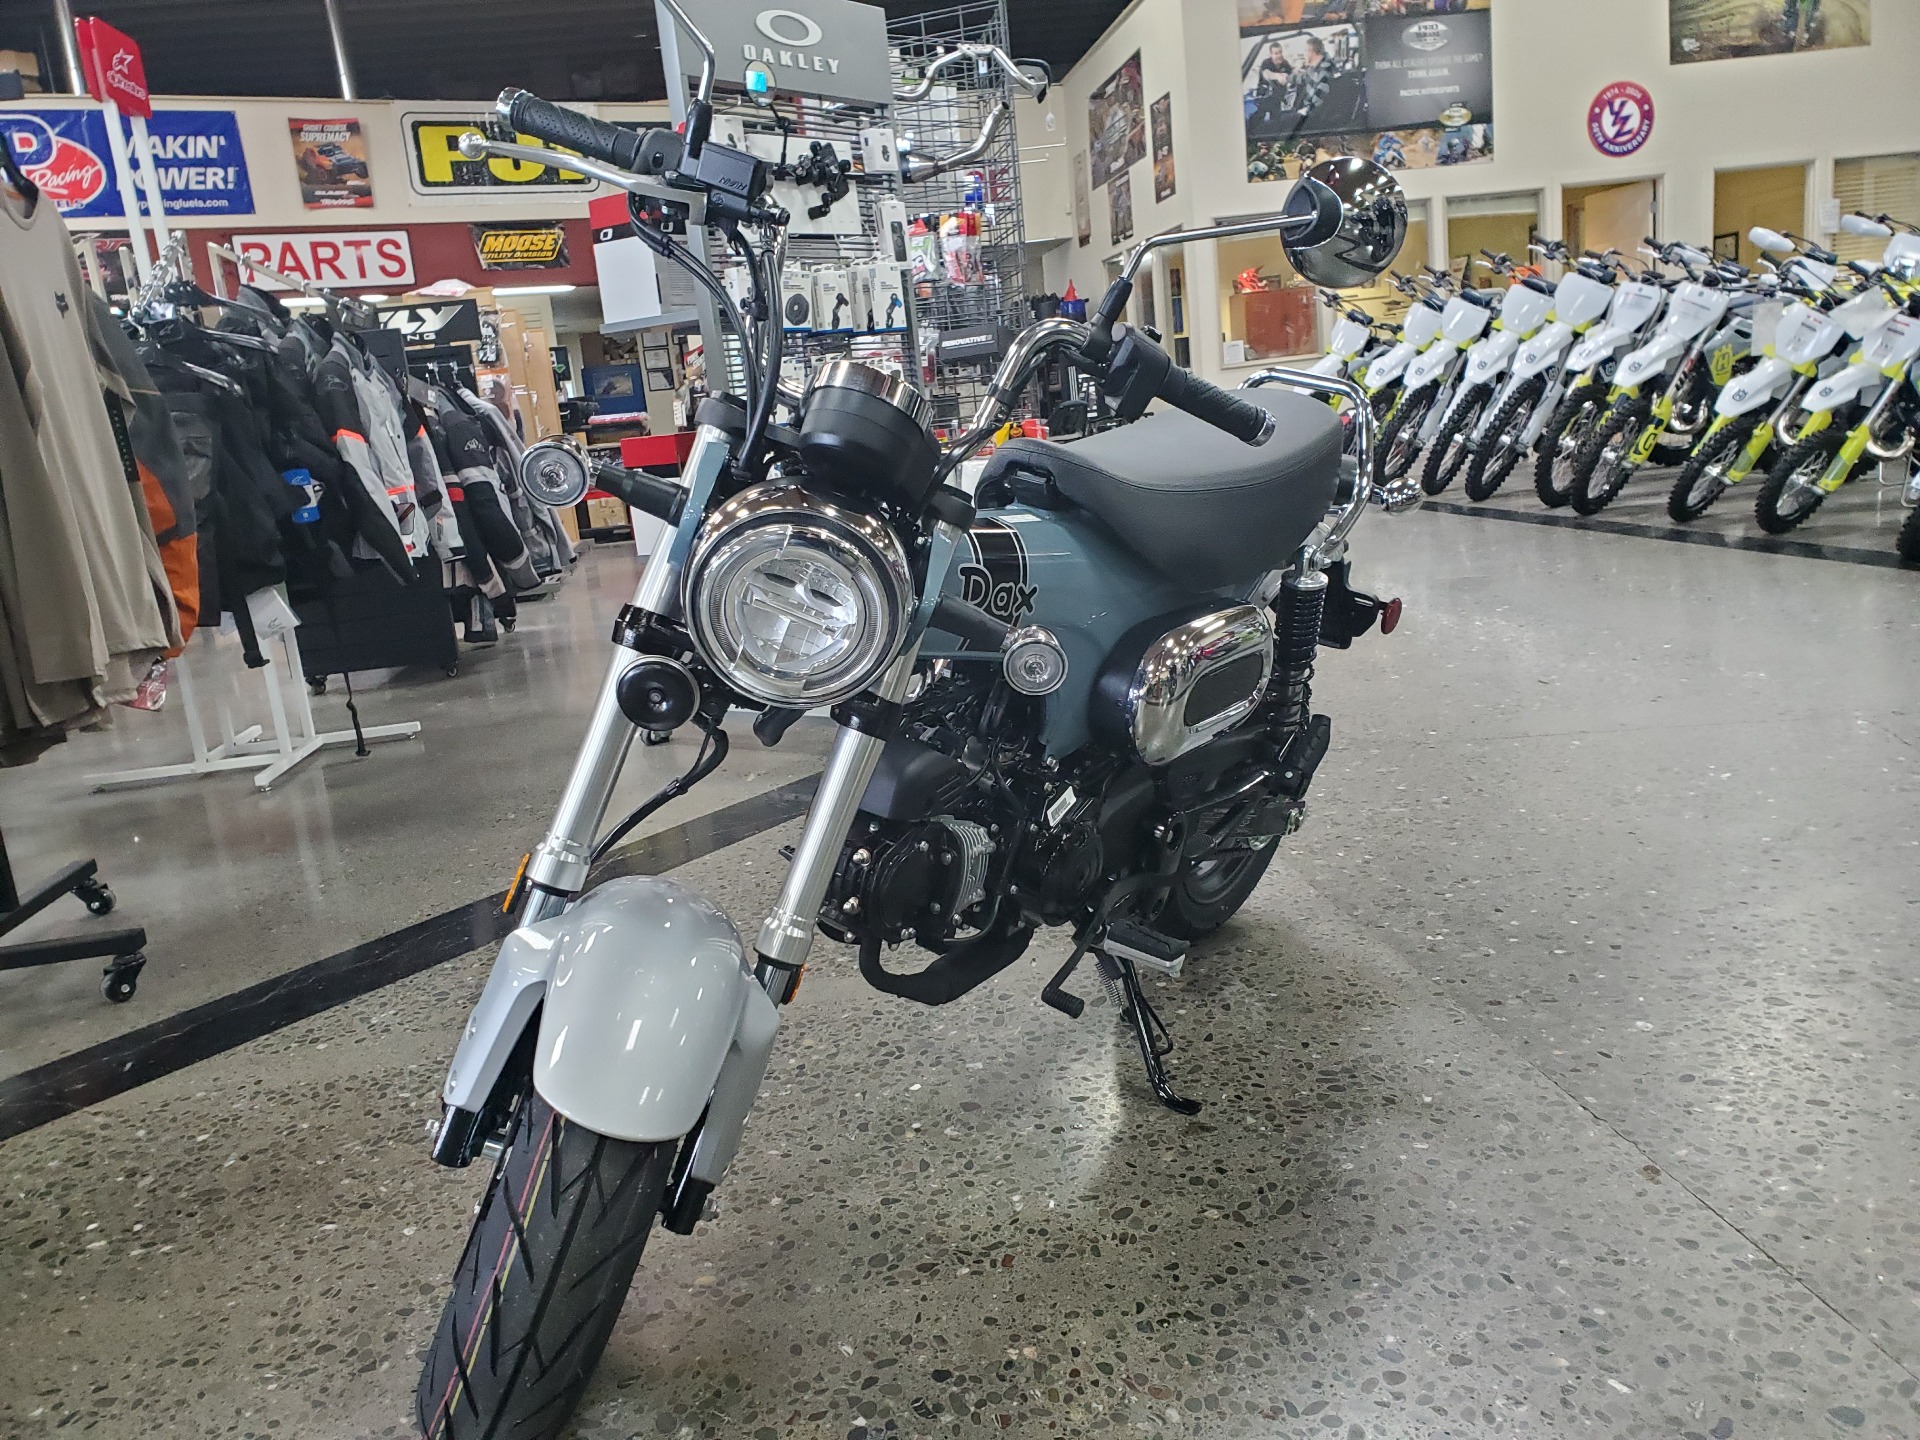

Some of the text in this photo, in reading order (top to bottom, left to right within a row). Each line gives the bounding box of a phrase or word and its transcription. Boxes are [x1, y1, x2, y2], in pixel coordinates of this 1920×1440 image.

[743, 44, 840, 74] OAKLEY
[300, 131, 351, 142] SUPREMACY
[1603, 118, 1651, 153] ANNIVERSARY
[29, 163, 99, 195] Racing
[483, 234, 557, 253] MOOSE
[513, 250, 553, 258] DIVISION
[240, 238, 407, 283] PARTS
[957, 563, 1040, 618] Dax
